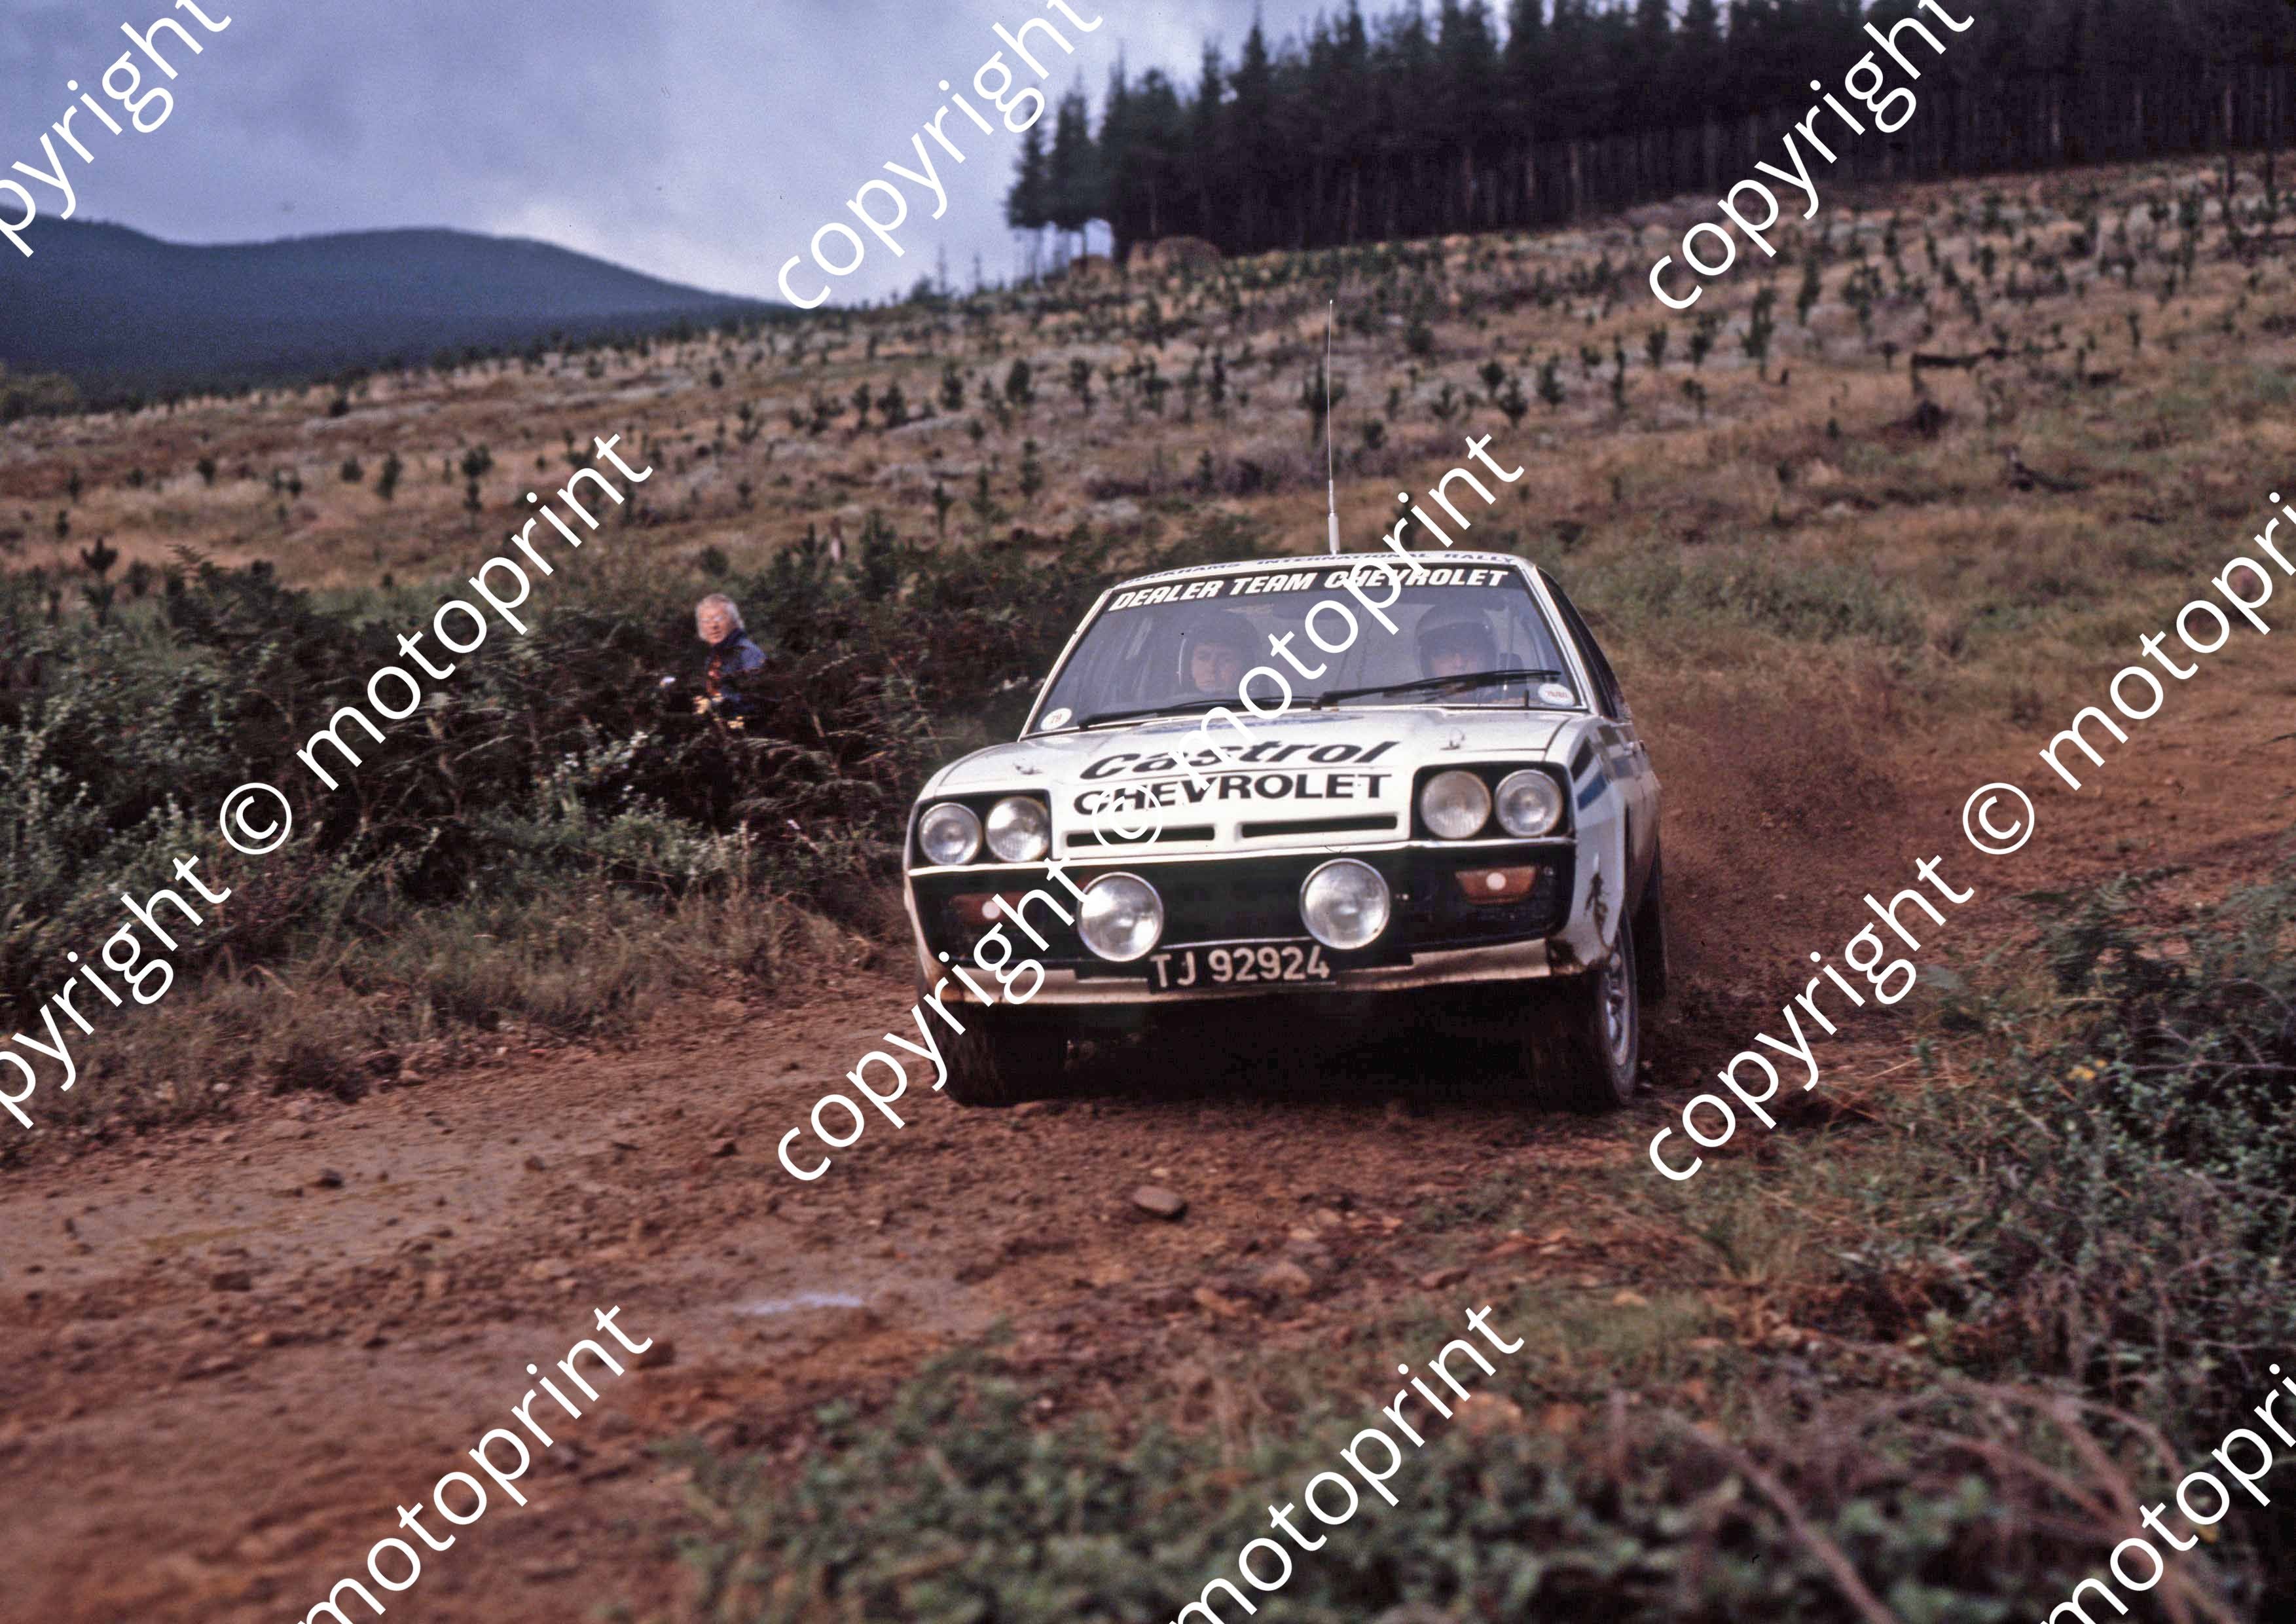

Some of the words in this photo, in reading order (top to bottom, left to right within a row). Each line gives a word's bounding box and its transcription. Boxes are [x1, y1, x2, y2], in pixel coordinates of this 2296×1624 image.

[1444, 553, 1514, 563] RALLY
[1108, 580, 1225, 611] DEALER
[1230, 572, 1318, 595] TEAM
[1324, 568, 1509, 588] CHEVROLET
[1080, 741, 1400, 779] Castrol
[1074, 773, 1391, 815] CHEVROLET
[1150, 951, 1196, 987] TJ
[1208, 945, 1330, 982] 92924
